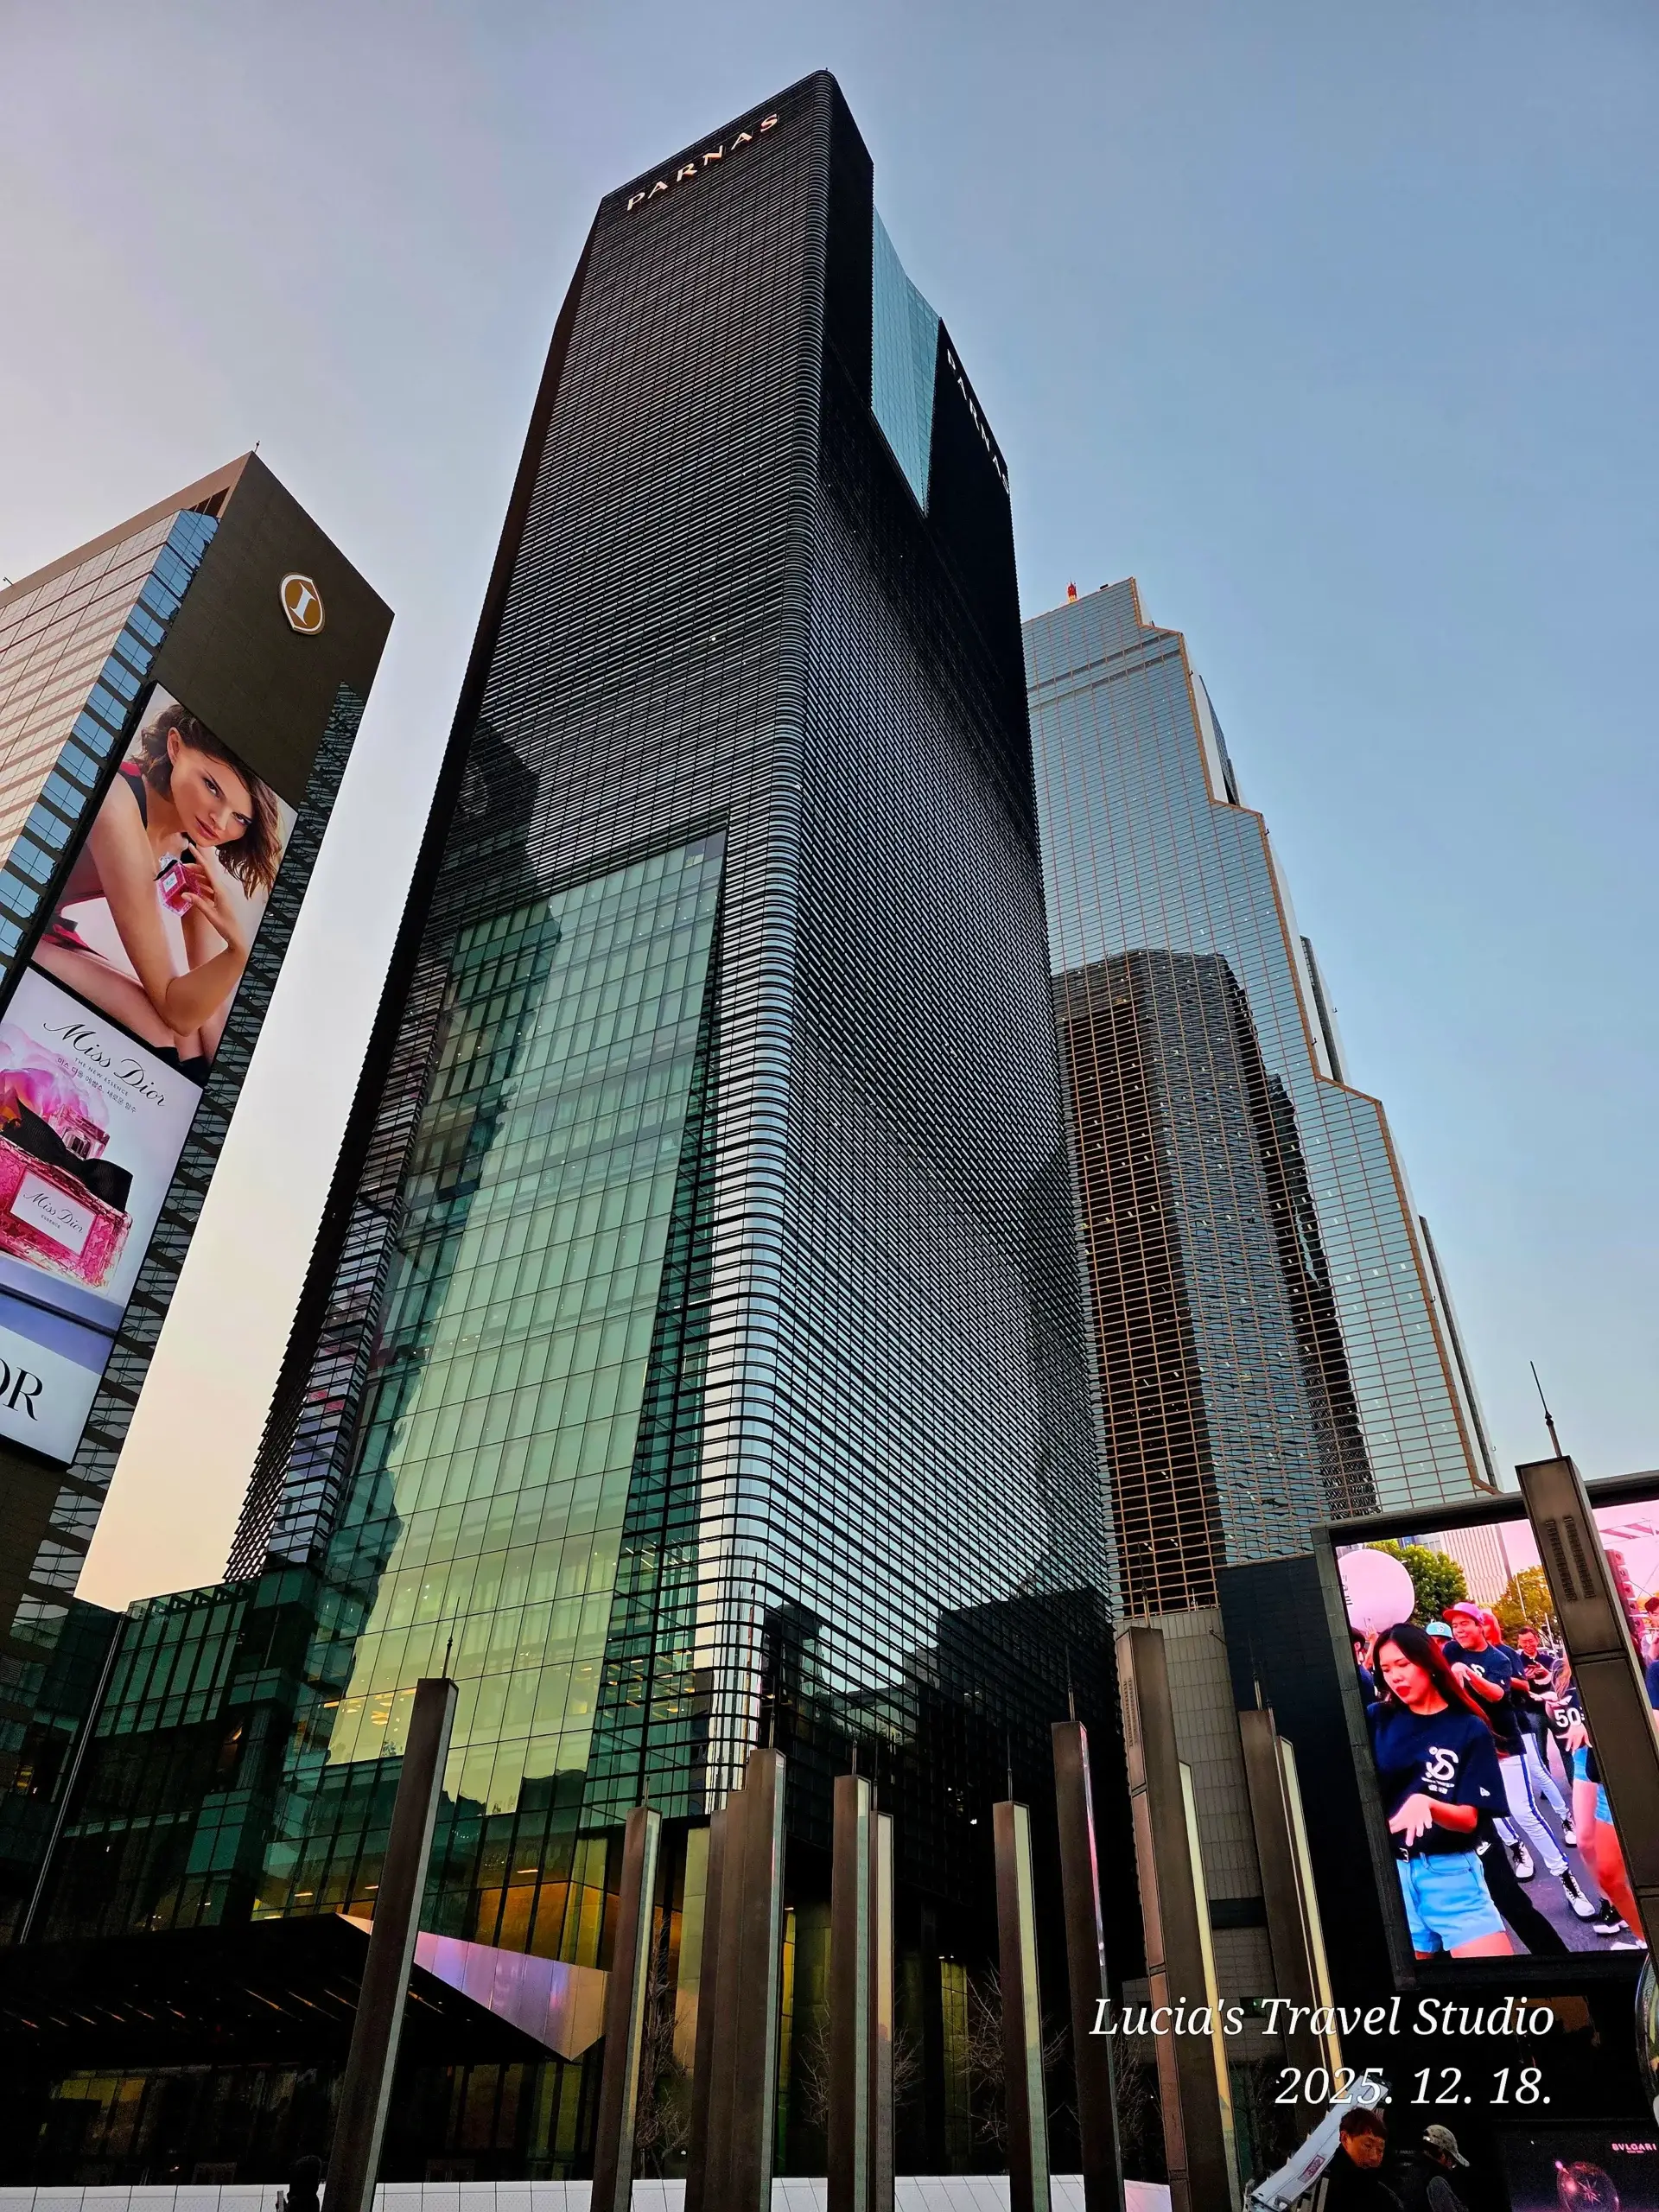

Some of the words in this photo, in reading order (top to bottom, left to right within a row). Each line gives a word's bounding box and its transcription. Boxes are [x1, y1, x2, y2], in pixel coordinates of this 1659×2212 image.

[627, 113, 779, 211] PARNAS
[43, 1023, 111, 1068] Miss
[113, 1058, 165, 1106] Dior
[57, 1058, 69, 1069] 미스
[74, 1057, 86, 1068] THE
[88, 1066, 103, 1077] NEW
[104, 1077, 129, 1096] ESSENCE
[22, 1193, 56, 1216] Miss
[57, 1209, 84, 1234] Dior
